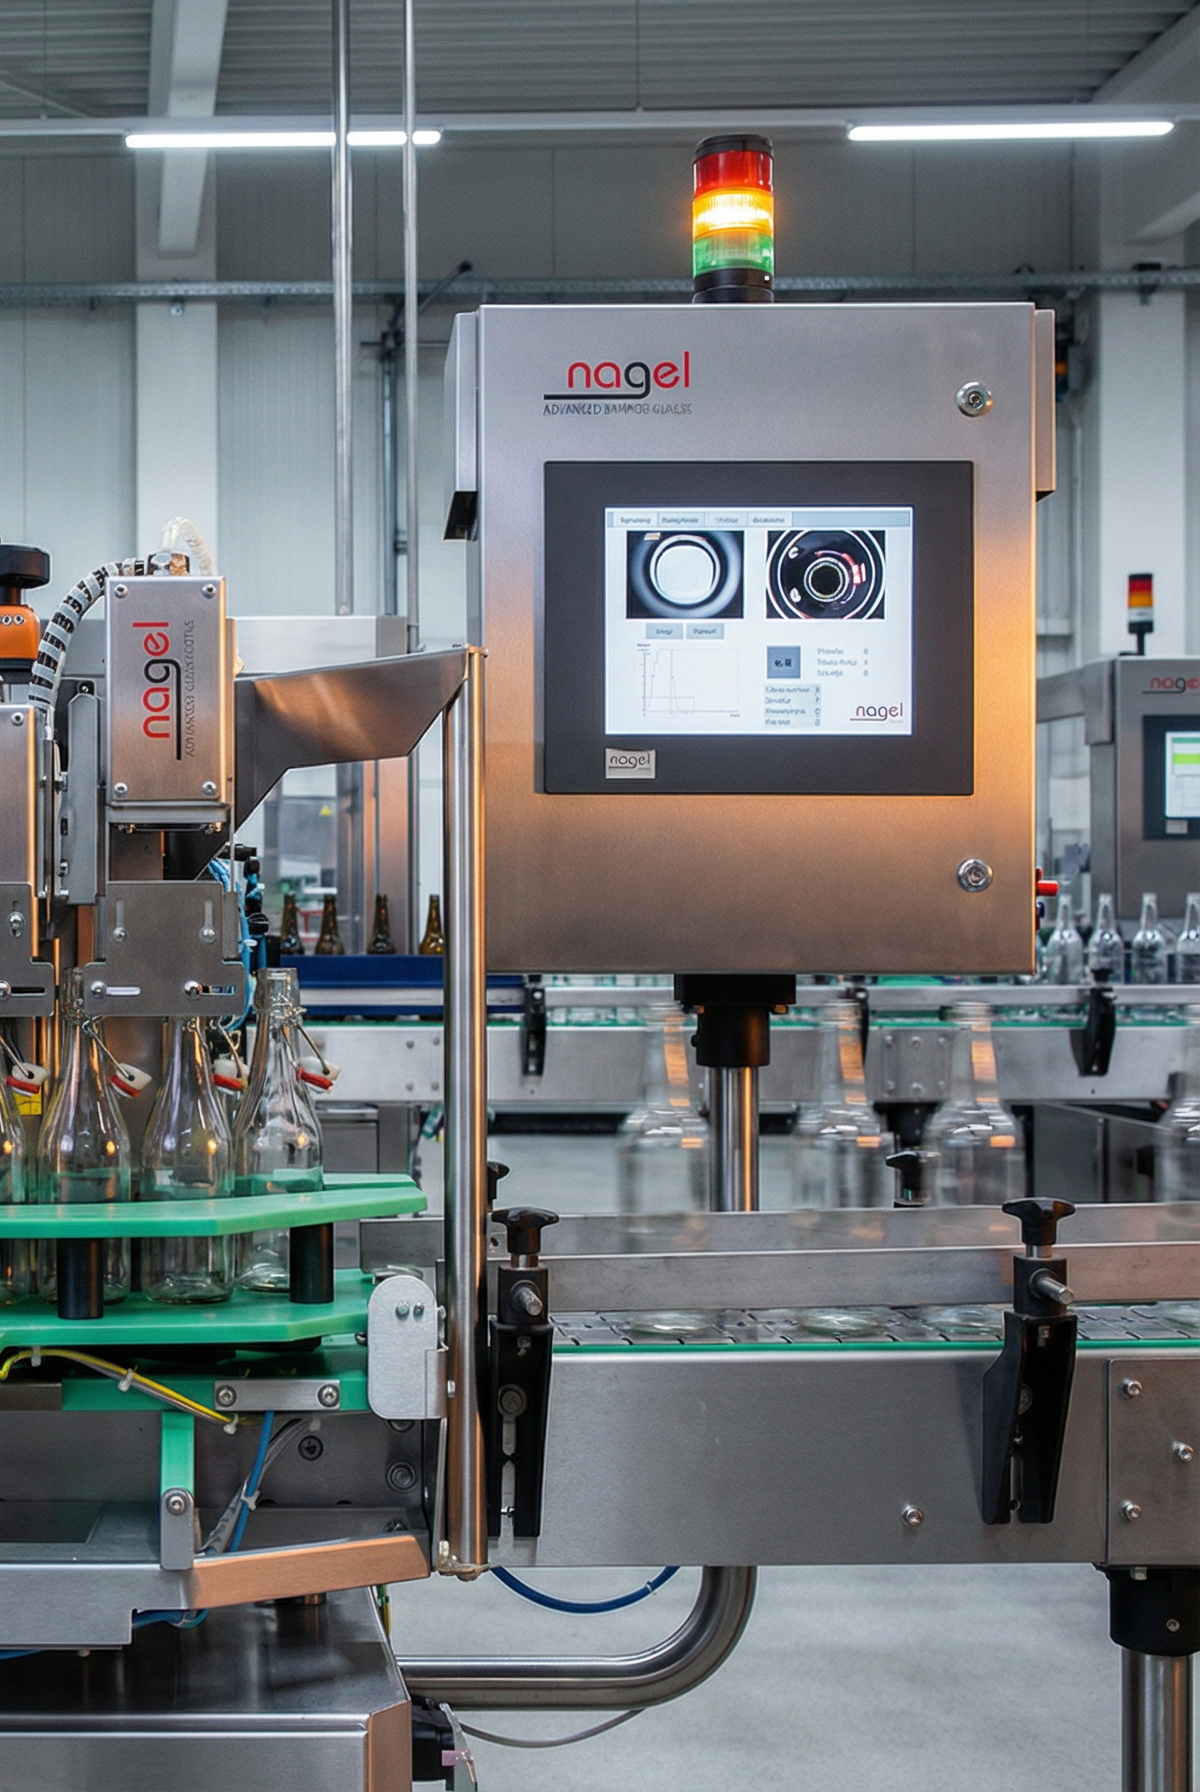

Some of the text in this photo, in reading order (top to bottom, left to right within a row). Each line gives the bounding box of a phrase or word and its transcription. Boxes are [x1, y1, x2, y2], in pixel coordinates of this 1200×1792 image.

[566, 350, 691, 400] nagel
[131, 621, 182, 739] nagel
[1149, 675, 1200, 695] nage
[855, 702, 904, 722] nagel
